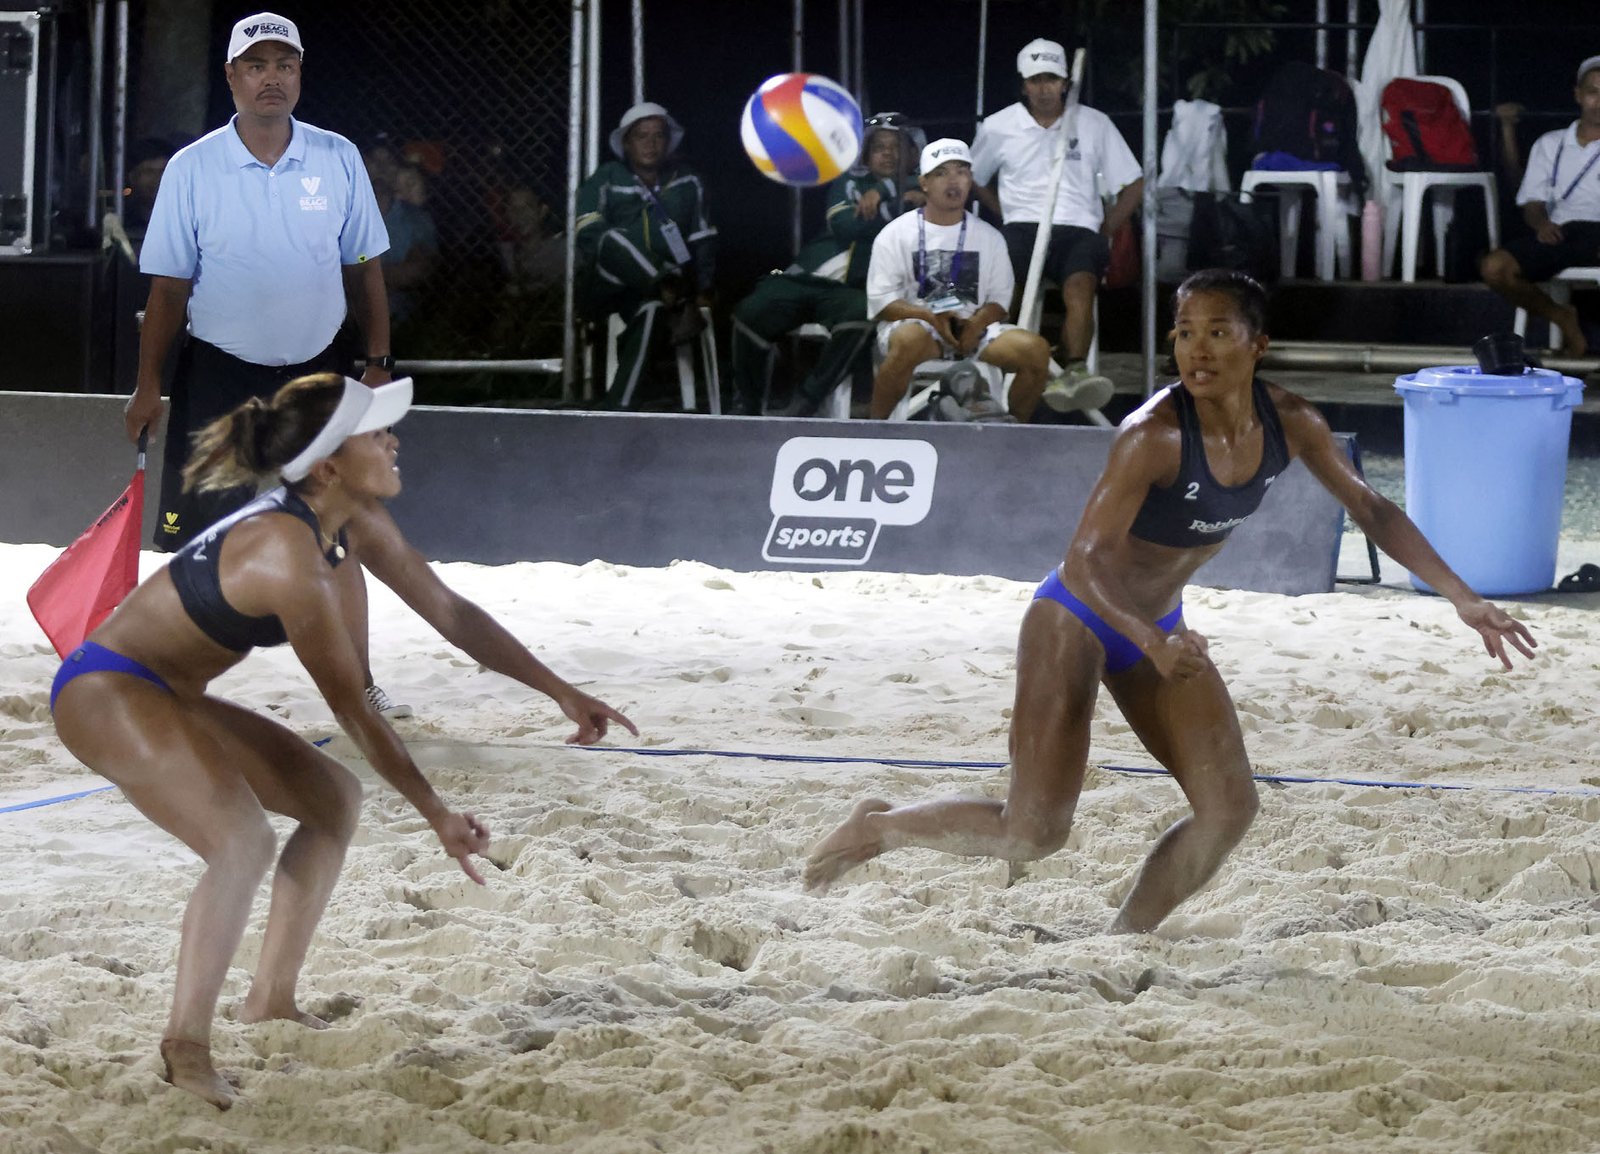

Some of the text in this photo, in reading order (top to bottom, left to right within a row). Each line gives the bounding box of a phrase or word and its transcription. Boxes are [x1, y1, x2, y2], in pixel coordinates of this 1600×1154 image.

[260, 25, 288, 34] BEACH
[300, 198, 327, 206] BEACH
[793, 457, 915, 504] one
[1184, 481, 1200, 500] 2
[775, 526, 867, 549] sports
